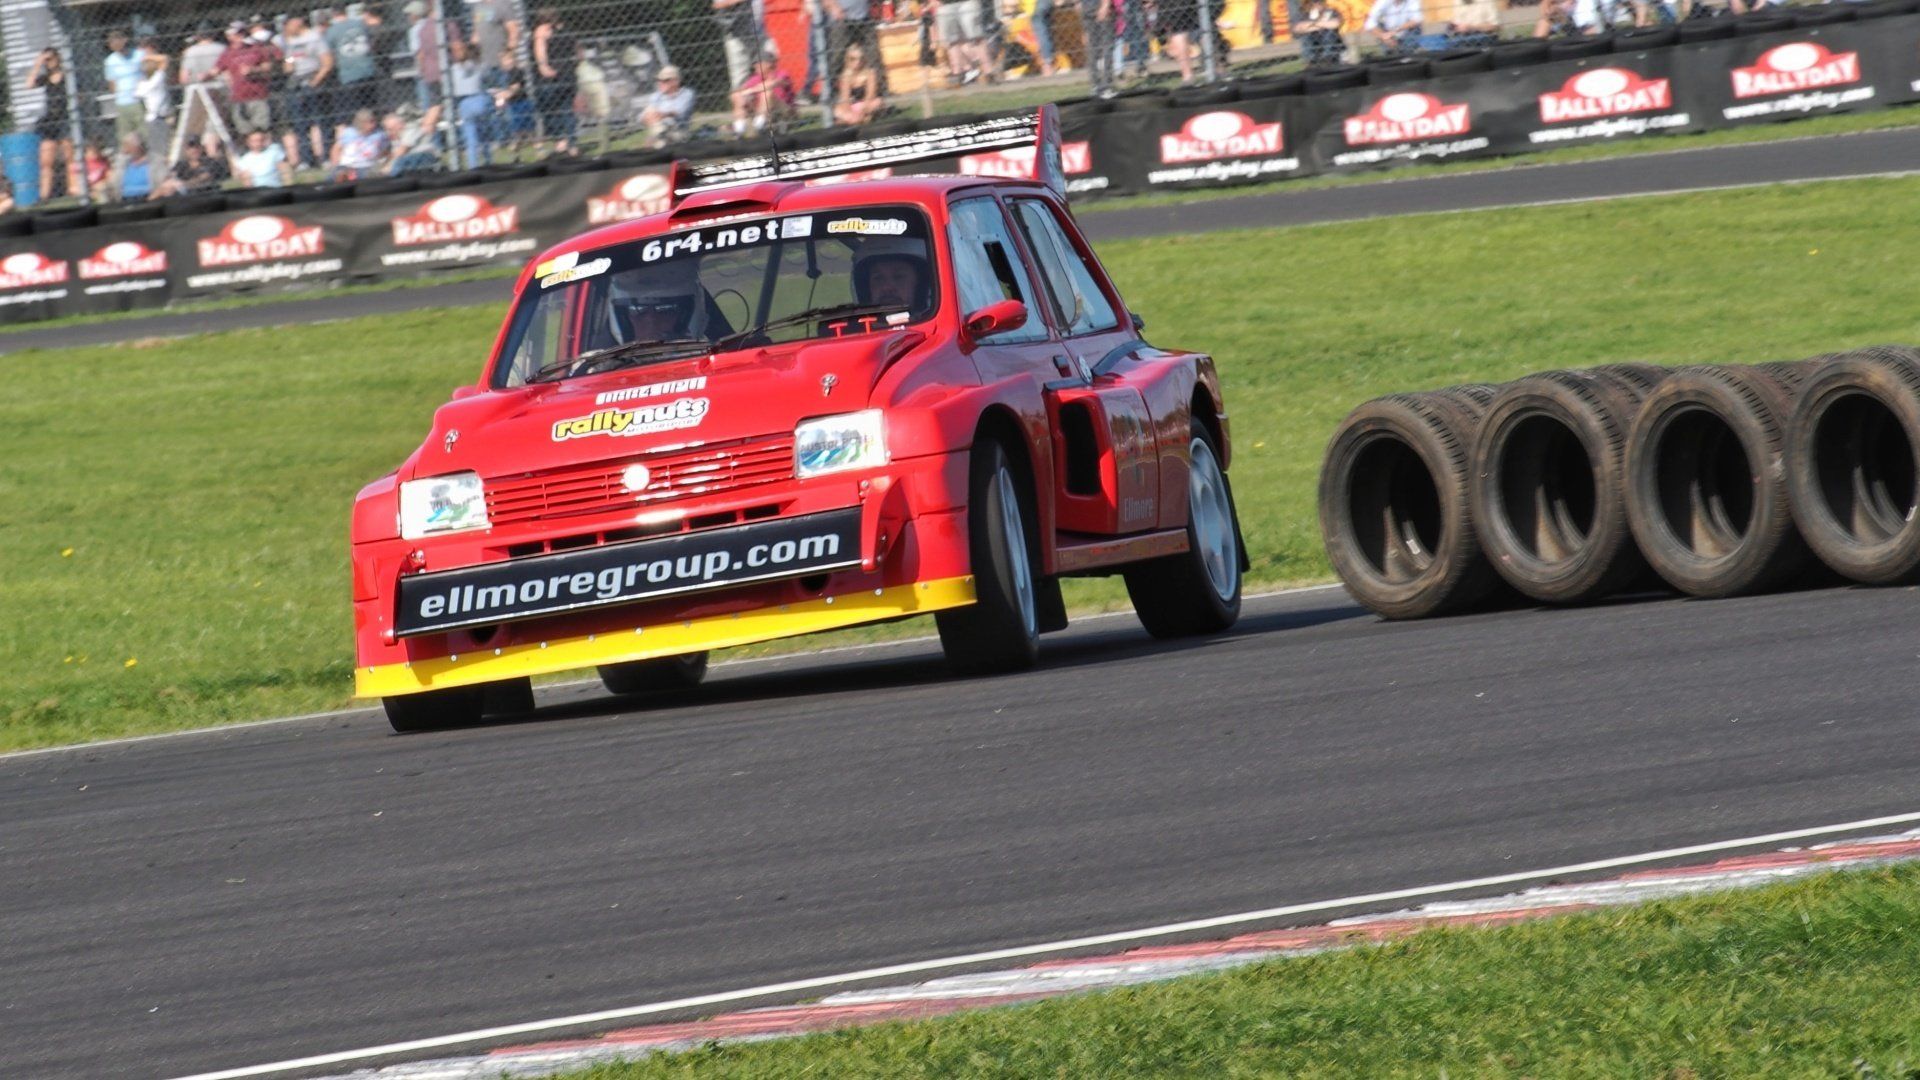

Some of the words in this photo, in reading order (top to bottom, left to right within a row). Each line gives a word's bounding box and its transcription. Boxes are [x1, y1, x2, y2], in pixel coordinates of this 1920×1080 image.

[1732, 52, 1858, 98] RALLYDAY
[1540, 79, 1669, 122] RALLYDAY
[1161, 122, 1282, 163] RALLYDAY
[1345, 104, 1469, 145] RALLYDAY
[198, 226, 322, 265] RALLYDAY
[392, 206, 517, 244] RALLYDAY
[642, 219, 779, 262] 6r4.net
[555, 400, 706, 438] rallynuts
[420, 533, 840, 618] ellmoregroup.com
